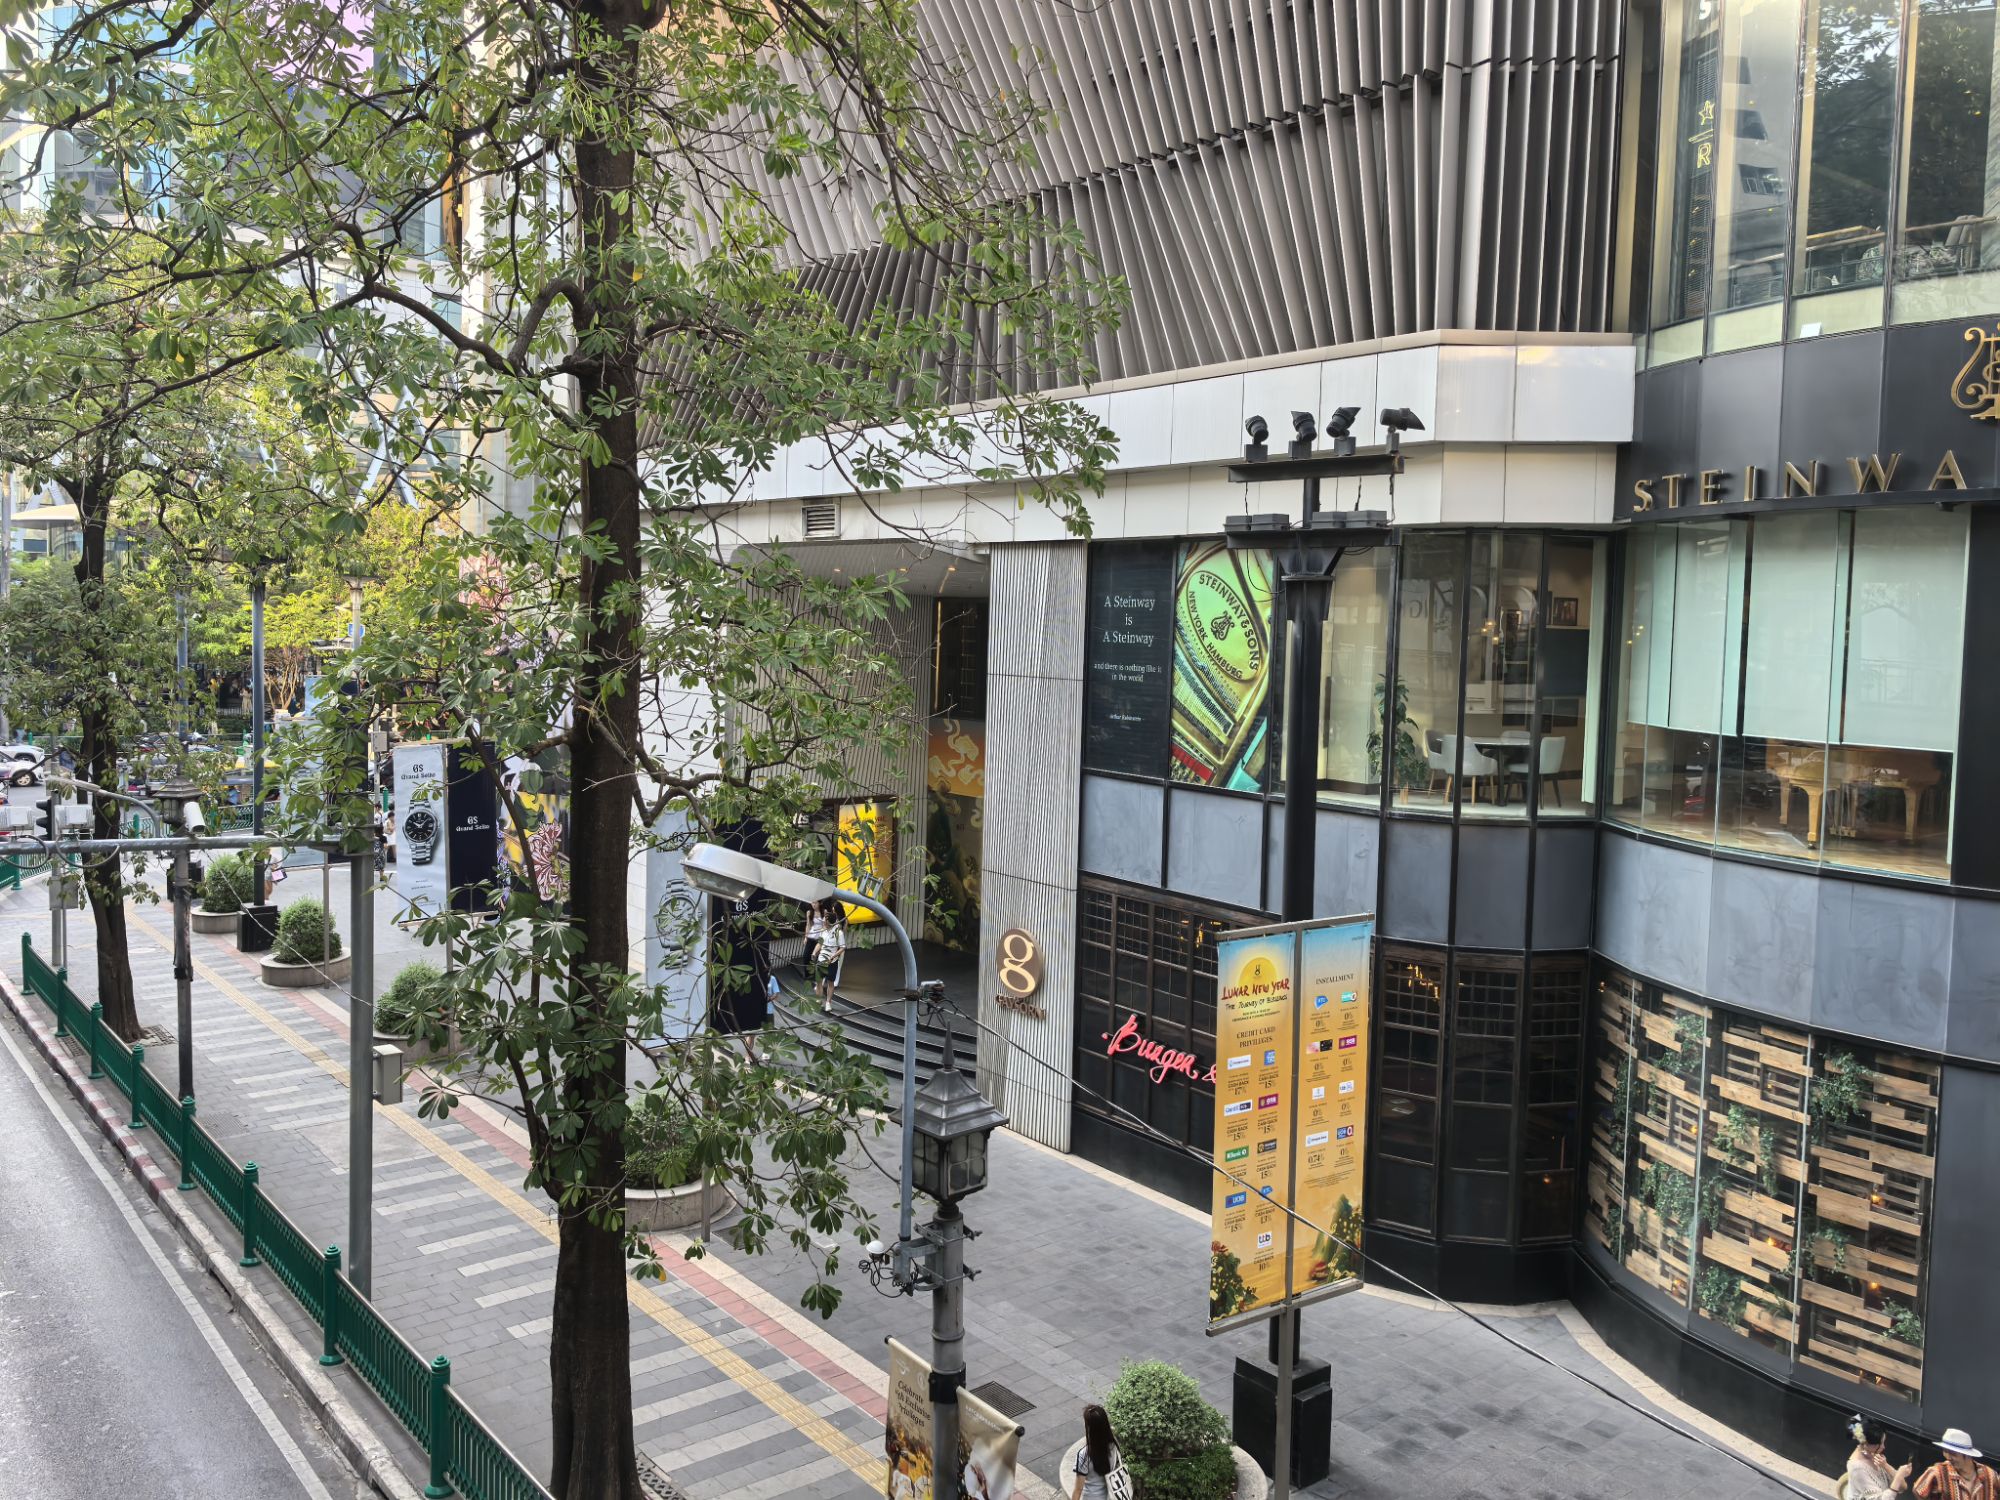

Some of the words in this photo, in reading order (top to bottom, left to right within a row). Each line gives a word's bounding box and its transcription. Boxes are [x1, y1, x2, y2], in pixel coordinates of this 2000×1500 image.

[1104, 596, 1112, 608] A
[1114, 595, 1156, 611] Steinway
[1125, 613, 1132, 626] is
[1189, 591, 1198, 613] NEW
[1194, 614, 1208, 642] YORK
[1198, 574, 1246, 619] STEINWAY
[1244, 628, 1260, 670] SONS
[1102, 631, 1110, 642] A
[1112, 630, 1154, 647] Steinway
[1105, 662, 1118, 670] there
[1125, 664, 1145, 673] nothing
[1206, 642, 1243, 679] HAMBURG
[1316, 973, 1354, 985] INSTALLMENT
[1222, 985, 1249, 1000] LUNAR
[1252, 984, 1269, 995] NEW
[1272, 978, 1290, 995] YEAR
[1237, 1030, 1258, 1039] CREDIT
[1260, 1026, 1276, 1034] CARD
